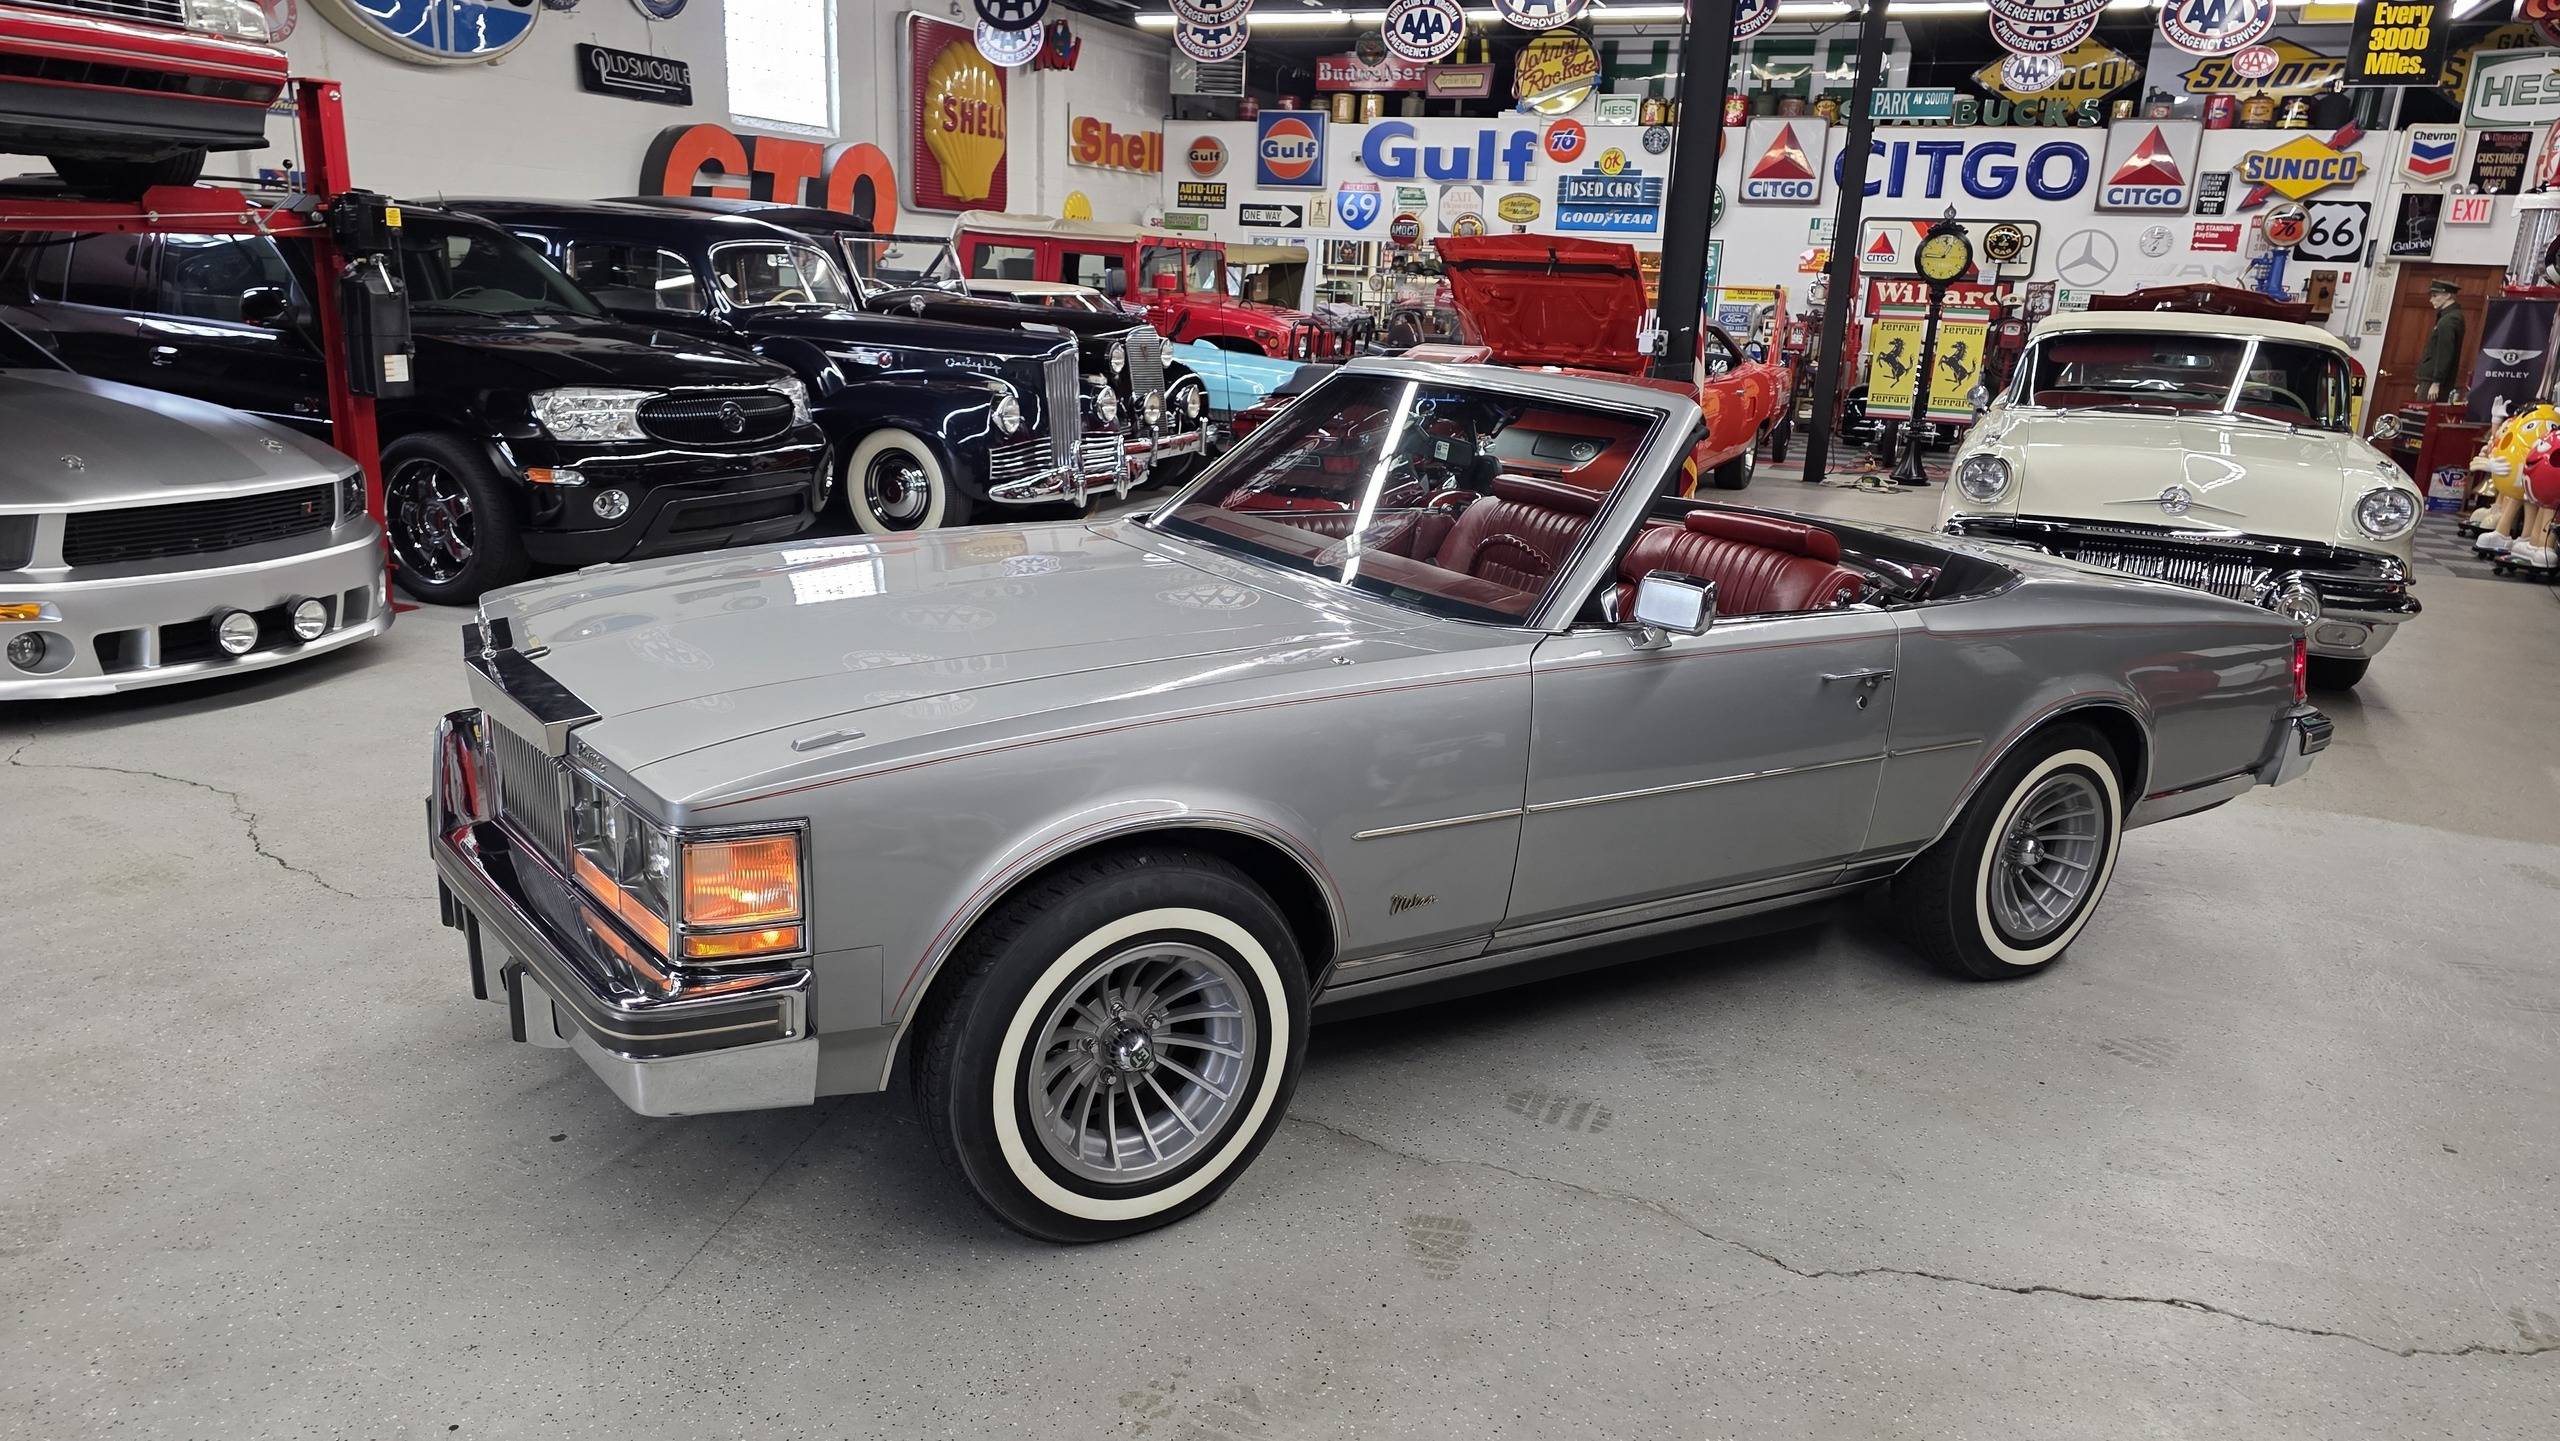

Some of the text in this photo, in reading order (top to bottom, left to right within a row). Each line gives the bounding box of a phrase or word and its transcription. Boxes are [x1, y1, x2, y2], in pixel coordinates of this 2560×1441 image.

[1174, 0, 1220, 24] MERGENCY
[1387, 2, 1404, 24] AUTO
[1433, 0, 1460, 23] VIRGINIA
[1507, 12, 1571, 28] APPROVED
[1992, 0, 2058, 22] EMERGENCY
[2185, 0, 2246, 35] AAA
[2374, 2, 2435, 28] Every
[1401, 9, 1444, 44] AAA
[1740, 7, 1774, 35] SERVICE
[1995, 20, 2089, 51] EMERGENCY SERVICE
[2165, 17, 2266, 50] EMERGENCY SERVICE
[2368, 27, 2430, 51] 3000
[2497, 33, 2540, 50] GAS
[1178, 31, 1219, 58] EMERGENCY
[1219, 33, 1245, 56] SERVICE
[1386, 30, 1459, 58] EMERGENCY SERVICE
[1517, 38, 1588, 73] Johnny
[2241, 52, 2270, 68] AAA
[2364, 52, 2426, 75] Miles.
[591, 48, 692, 89] OLDSMOBILE
[1318, 62, 1426, 82] Budweiser
[2013, 56, 2050, 83] AAA
[1603, 105, 1633, 115] HESS
[1874, 92, 1950, 116] PARK AV SOUTH
[944, 96, 1006, 141] SHELL
[1071, 114, 1163, 174] Shell
[1551, 129, 1577, 151] 76
[2413, 131, 2458, 141] Chevron
[1189, 150, 1221, 161] Gulf
[1262, 139, 1318, 159] Gulf
[1361, 120, 1538, 182] Gulf
[2477, 152, 2525, 165] CUSTOMER
[1602, 153, 1621, 170] OK
[1834, 140, 2091, 202] CITGO
[2246, 155, 2358, 181] SUNOCO
[2479, 165, 2517, 178] WAITING
[654, 123, 898, 264] GTO
[1180, 183, 1226, 195] AUTO-LITE
[1569, 181, 1643, 198] USED CARS
[1748, 181, 1813, 198] CITGO
[2481, 179, 2507, 190] AREA
[1179, 194, 1202, 202] SPARK
[2107, 187, 2182, 206] CITGO
[1244, 210, 1282, 221] ONE WAY
[1342, 194, 1377, 221] 69
[2452, 199, 2491, 221] EXIT
[1561, 211, 1654, 226] GOODYEAR
[2252, 218, 2262, 227] NO
[2275, 219, 2297, 237] 76
[1391, 223, 1419, 237] AMOCO
[2195, 232, 2219, 240] Anytime
[2205, 225, 2235, 233] STANDING
[2307, 216, 2354, 247] 66
[2392, 238, 2433, 252] Gabriel
[1866, 254, 1895, 263] CITGO
[1875, 282, 2004, 306] Wilard
[2060, 290, 2070, 301] 2
[1726, 313, 1746, 323] Ford
[1880, 321, 1921, 333] Ferrari
[1943, 324, 1984, 336] Ferrari
[2485, 370, 2530, 379] BENTLEY
[1870, 393, 1910, 404] Ferrari
[2439, 471, 2466, 488] VP
